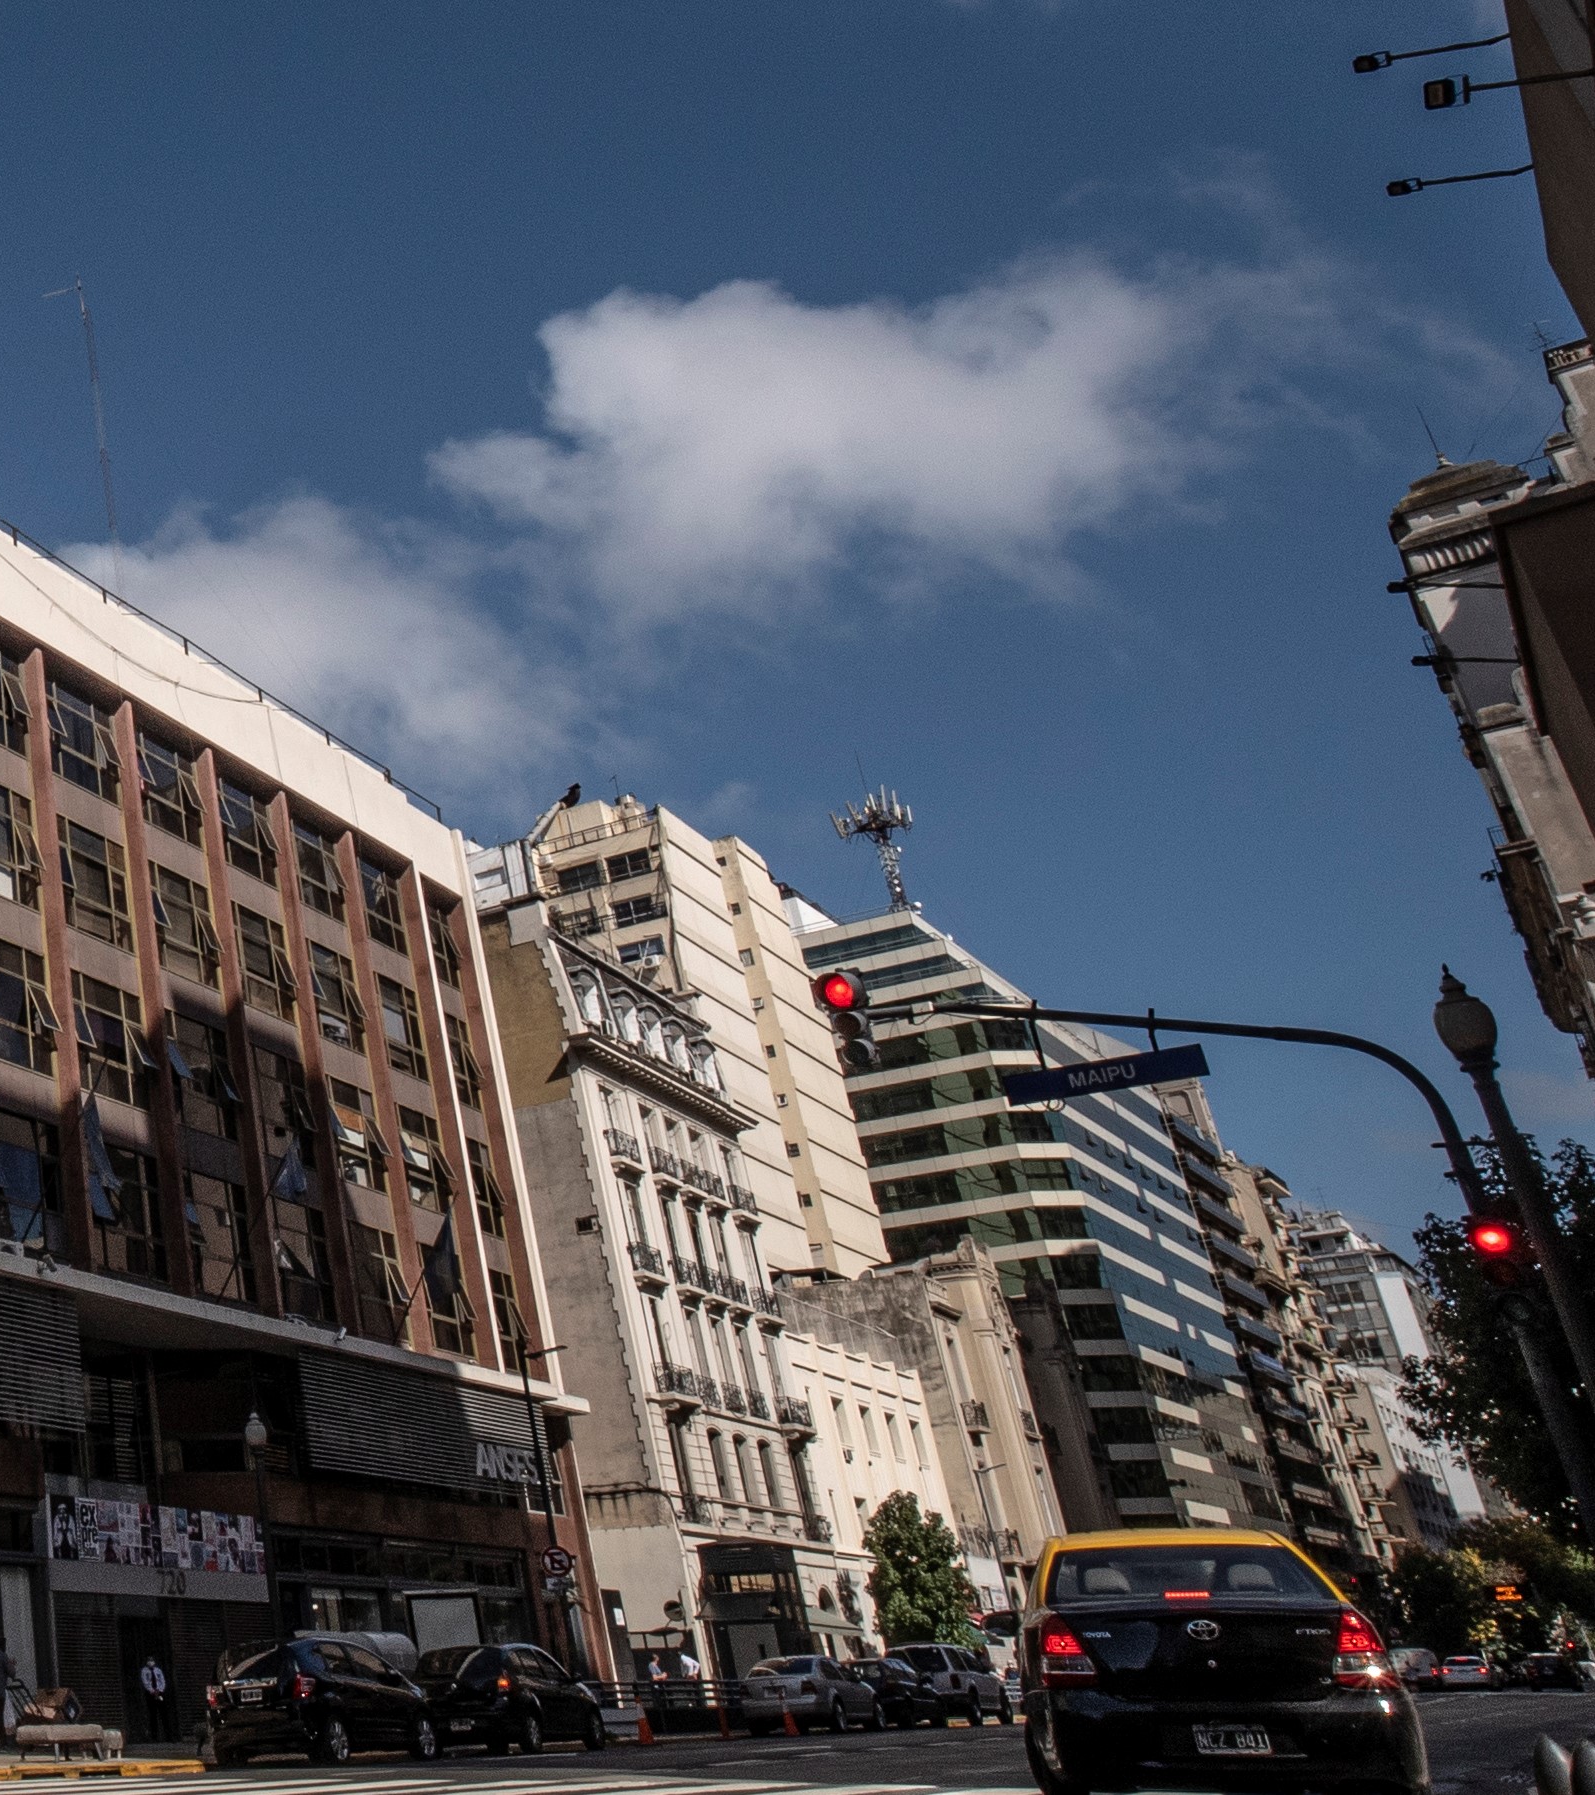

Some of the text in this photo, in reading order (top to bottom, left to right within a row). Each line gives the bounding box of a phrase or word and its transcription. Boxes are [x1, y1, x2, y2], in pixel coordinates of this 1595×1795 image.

[1067, 1063, 1136, 1089] MAIPU
[476, 1442, 541, 1484] ANSES
[80, 1503, 97, 1526] ex
[157, 1569, 187, 1595] 720
[1196, 1732, 1268, 1748] NCZ 841
